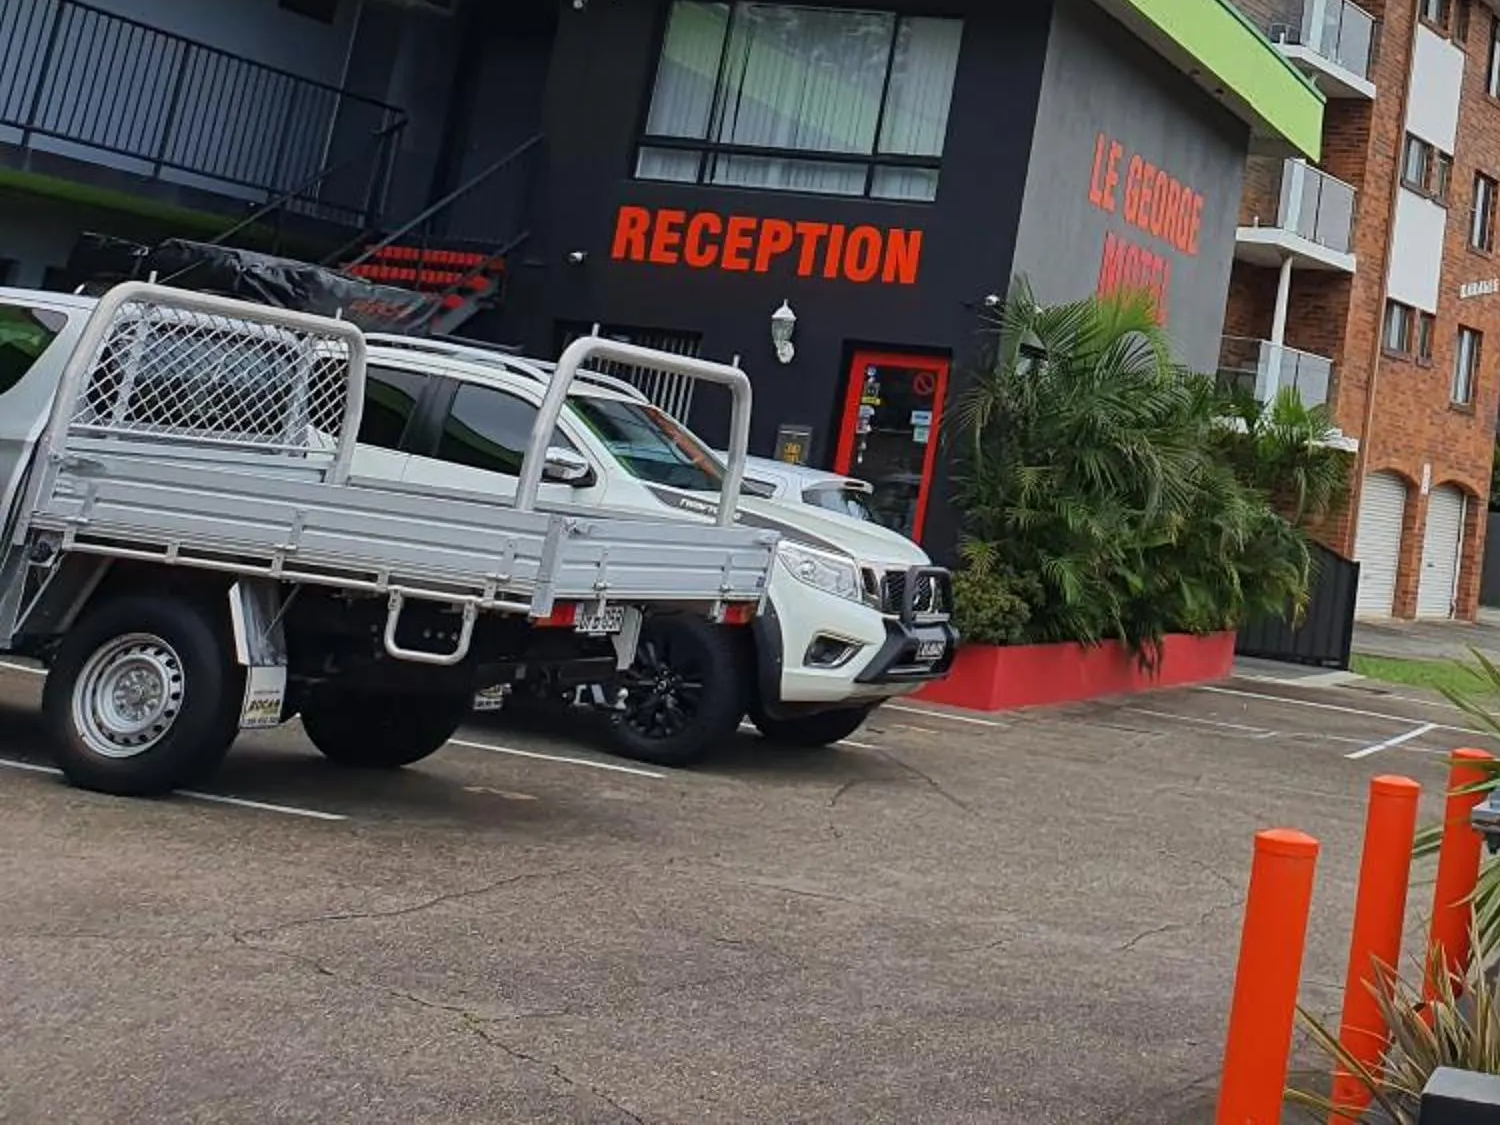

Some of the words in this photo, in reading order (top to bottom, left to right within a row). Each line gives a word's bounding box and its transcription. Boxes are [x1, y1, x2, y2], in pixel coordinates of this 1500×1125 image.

[1088, 131, 1123, 213] LE
[1123, 154, 1204, 256] GEORGE
[611, 205, 923, 285] RECEPTION
